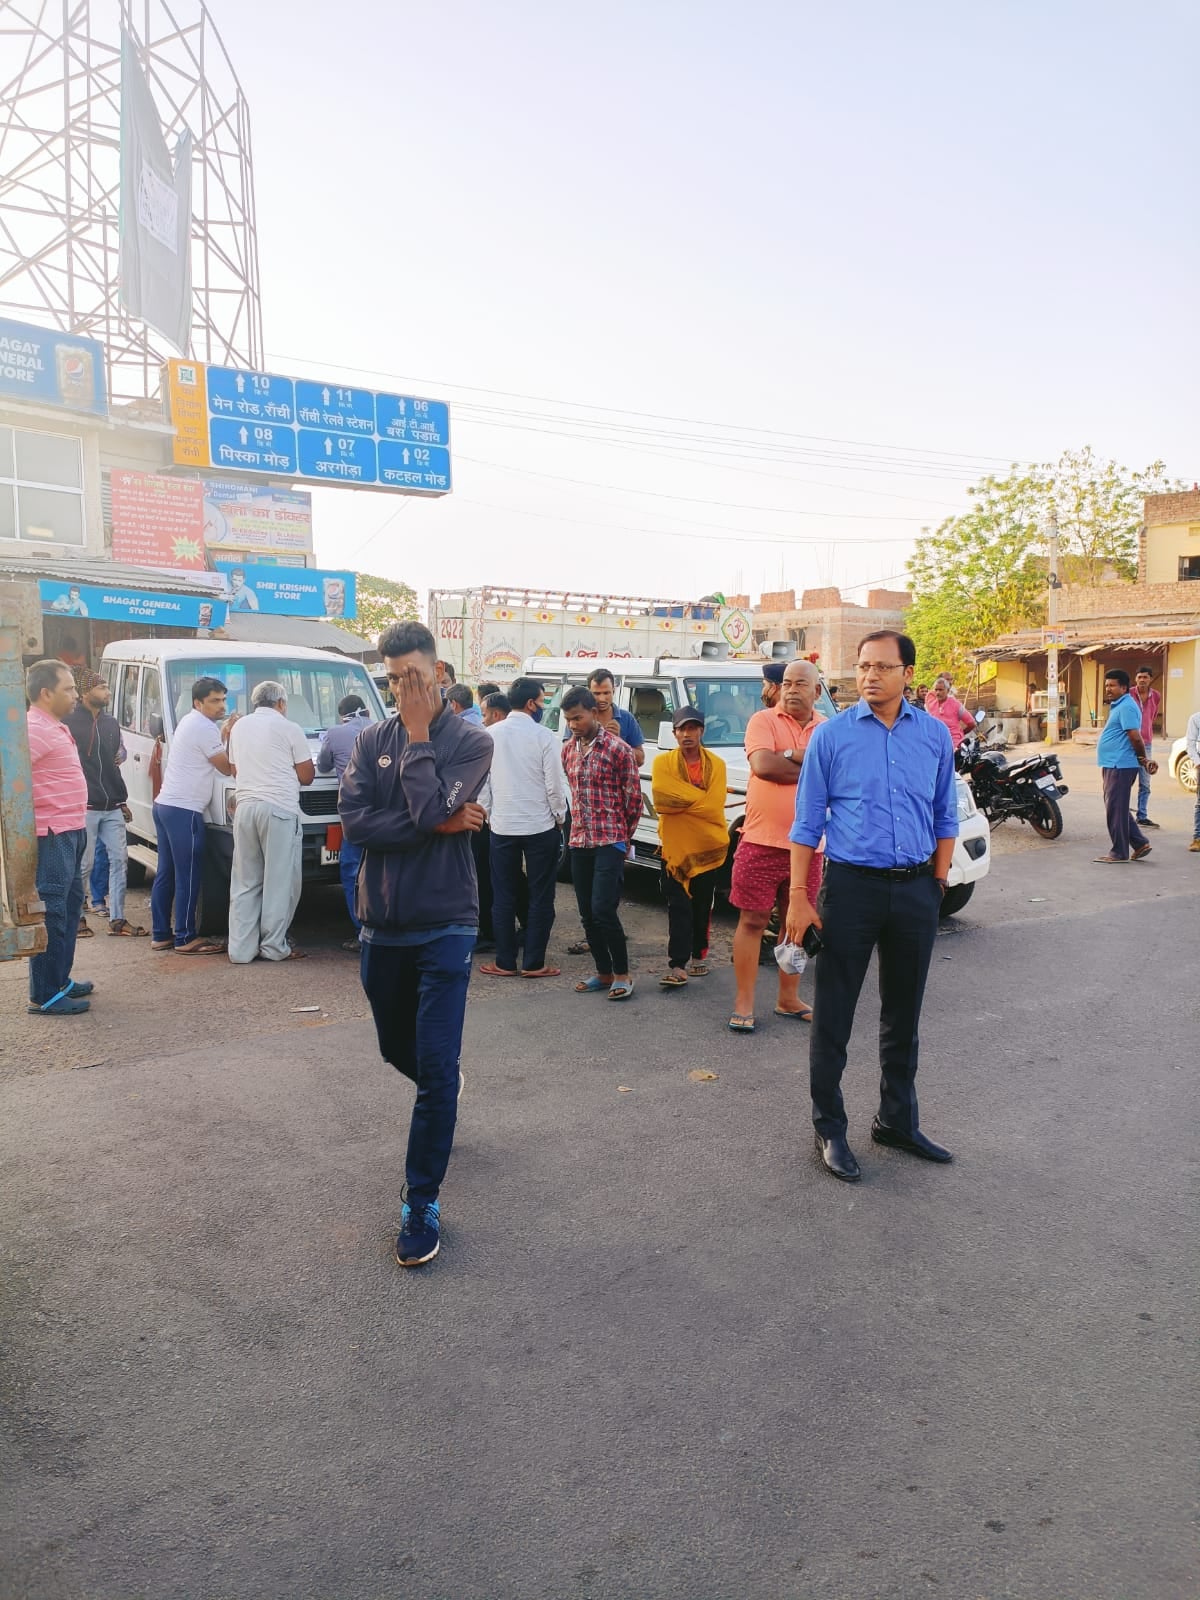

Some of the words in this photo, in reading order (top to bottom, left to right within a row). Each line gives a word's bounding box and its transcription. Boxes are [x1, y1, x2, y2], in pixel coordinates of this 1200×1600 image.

[251, 375, 270, 389] 10
[336, 389, 352, 402] 11
[212, 394, 233, 411] मेन
[413, 400, 429, 412] 06
[322, 412, 344, 427] रेलवे
[346, 415, 374, 431] स्टेशन
[254, 427, 273, 441] 08
[386, 426, 406, 438] बस
[338, 438, 356, 451] 07
[219, 444, 260, 464] पिस्का
[413, 448, 430, 461] 02
[384, 469, 422, 483] कटहल
[256, 581, 277, 591] SHRI
[279, 583, 318, 593] KRISHNA
[273, 591, 302, 600] STORE
[103, 596, 141, 607] BHAGAT
[143, 599, 181, 611] GENERAL
[128, 606, 157, 617] STORE
[441, 619, 464, 639] 2022
